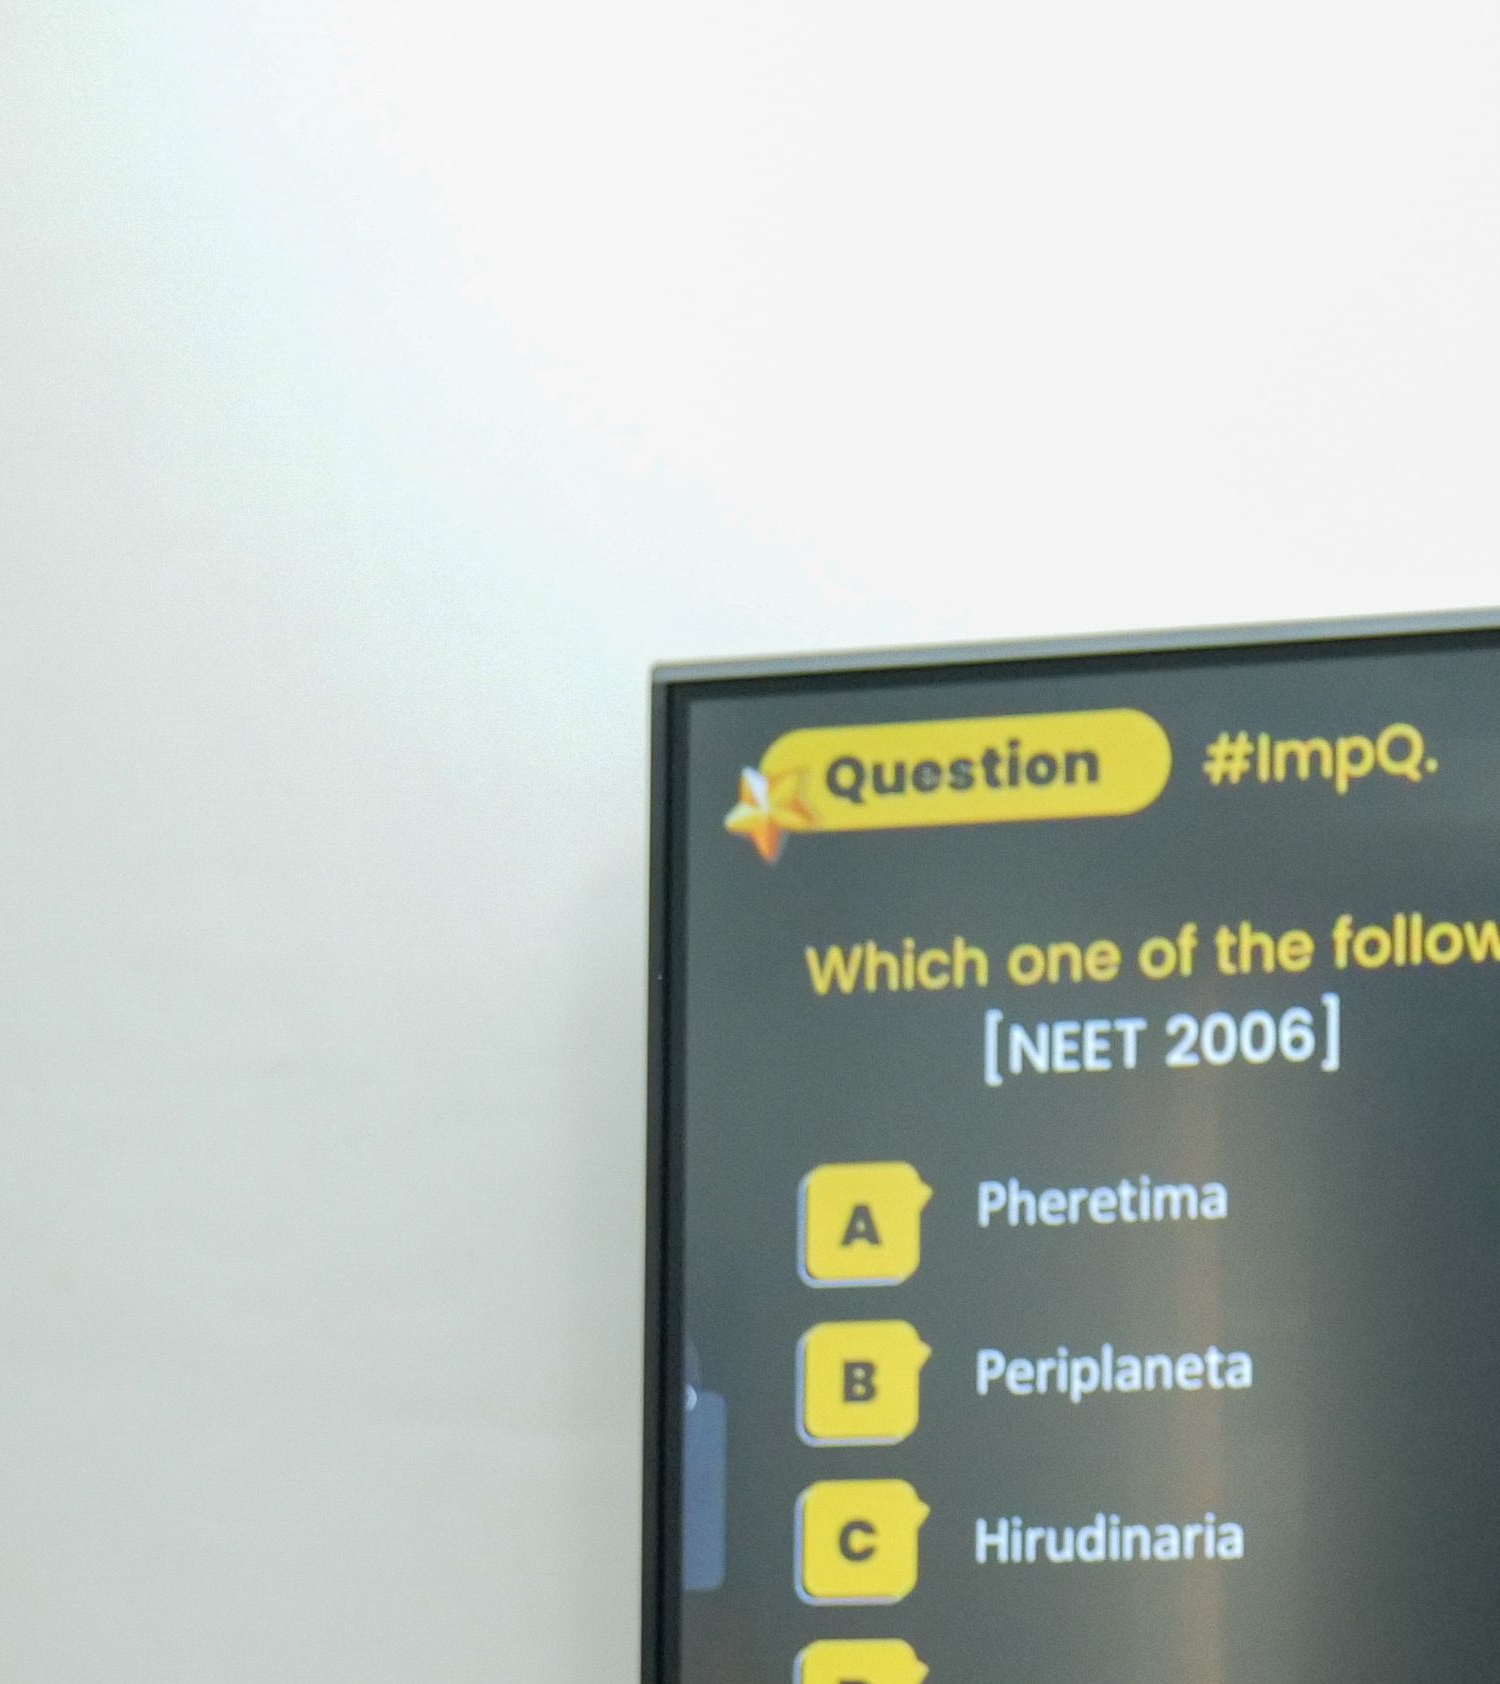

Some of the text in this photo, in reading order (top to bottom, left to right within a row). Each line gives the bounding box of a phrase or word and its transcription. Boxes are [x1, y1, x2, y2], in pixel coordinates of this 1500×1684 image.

[825, 740, 1100, 803] Question
[1203, 722, 1439, 795] #ImpQ.
[805, 935, 989, 995] Which
[1007, 939, 1122, 986] one
[1137, 922, 1198, 980] of
[1214, 920, 1315, 976] the
[984, 992, 1340, 1087] [NEET 2006]
[840, 1174, 1228, 1248] A Pheretima
[842, 1342, 1253, 1404] B Periplaneta
[837, 1511, 1245, 1564] C Hirudinaria
